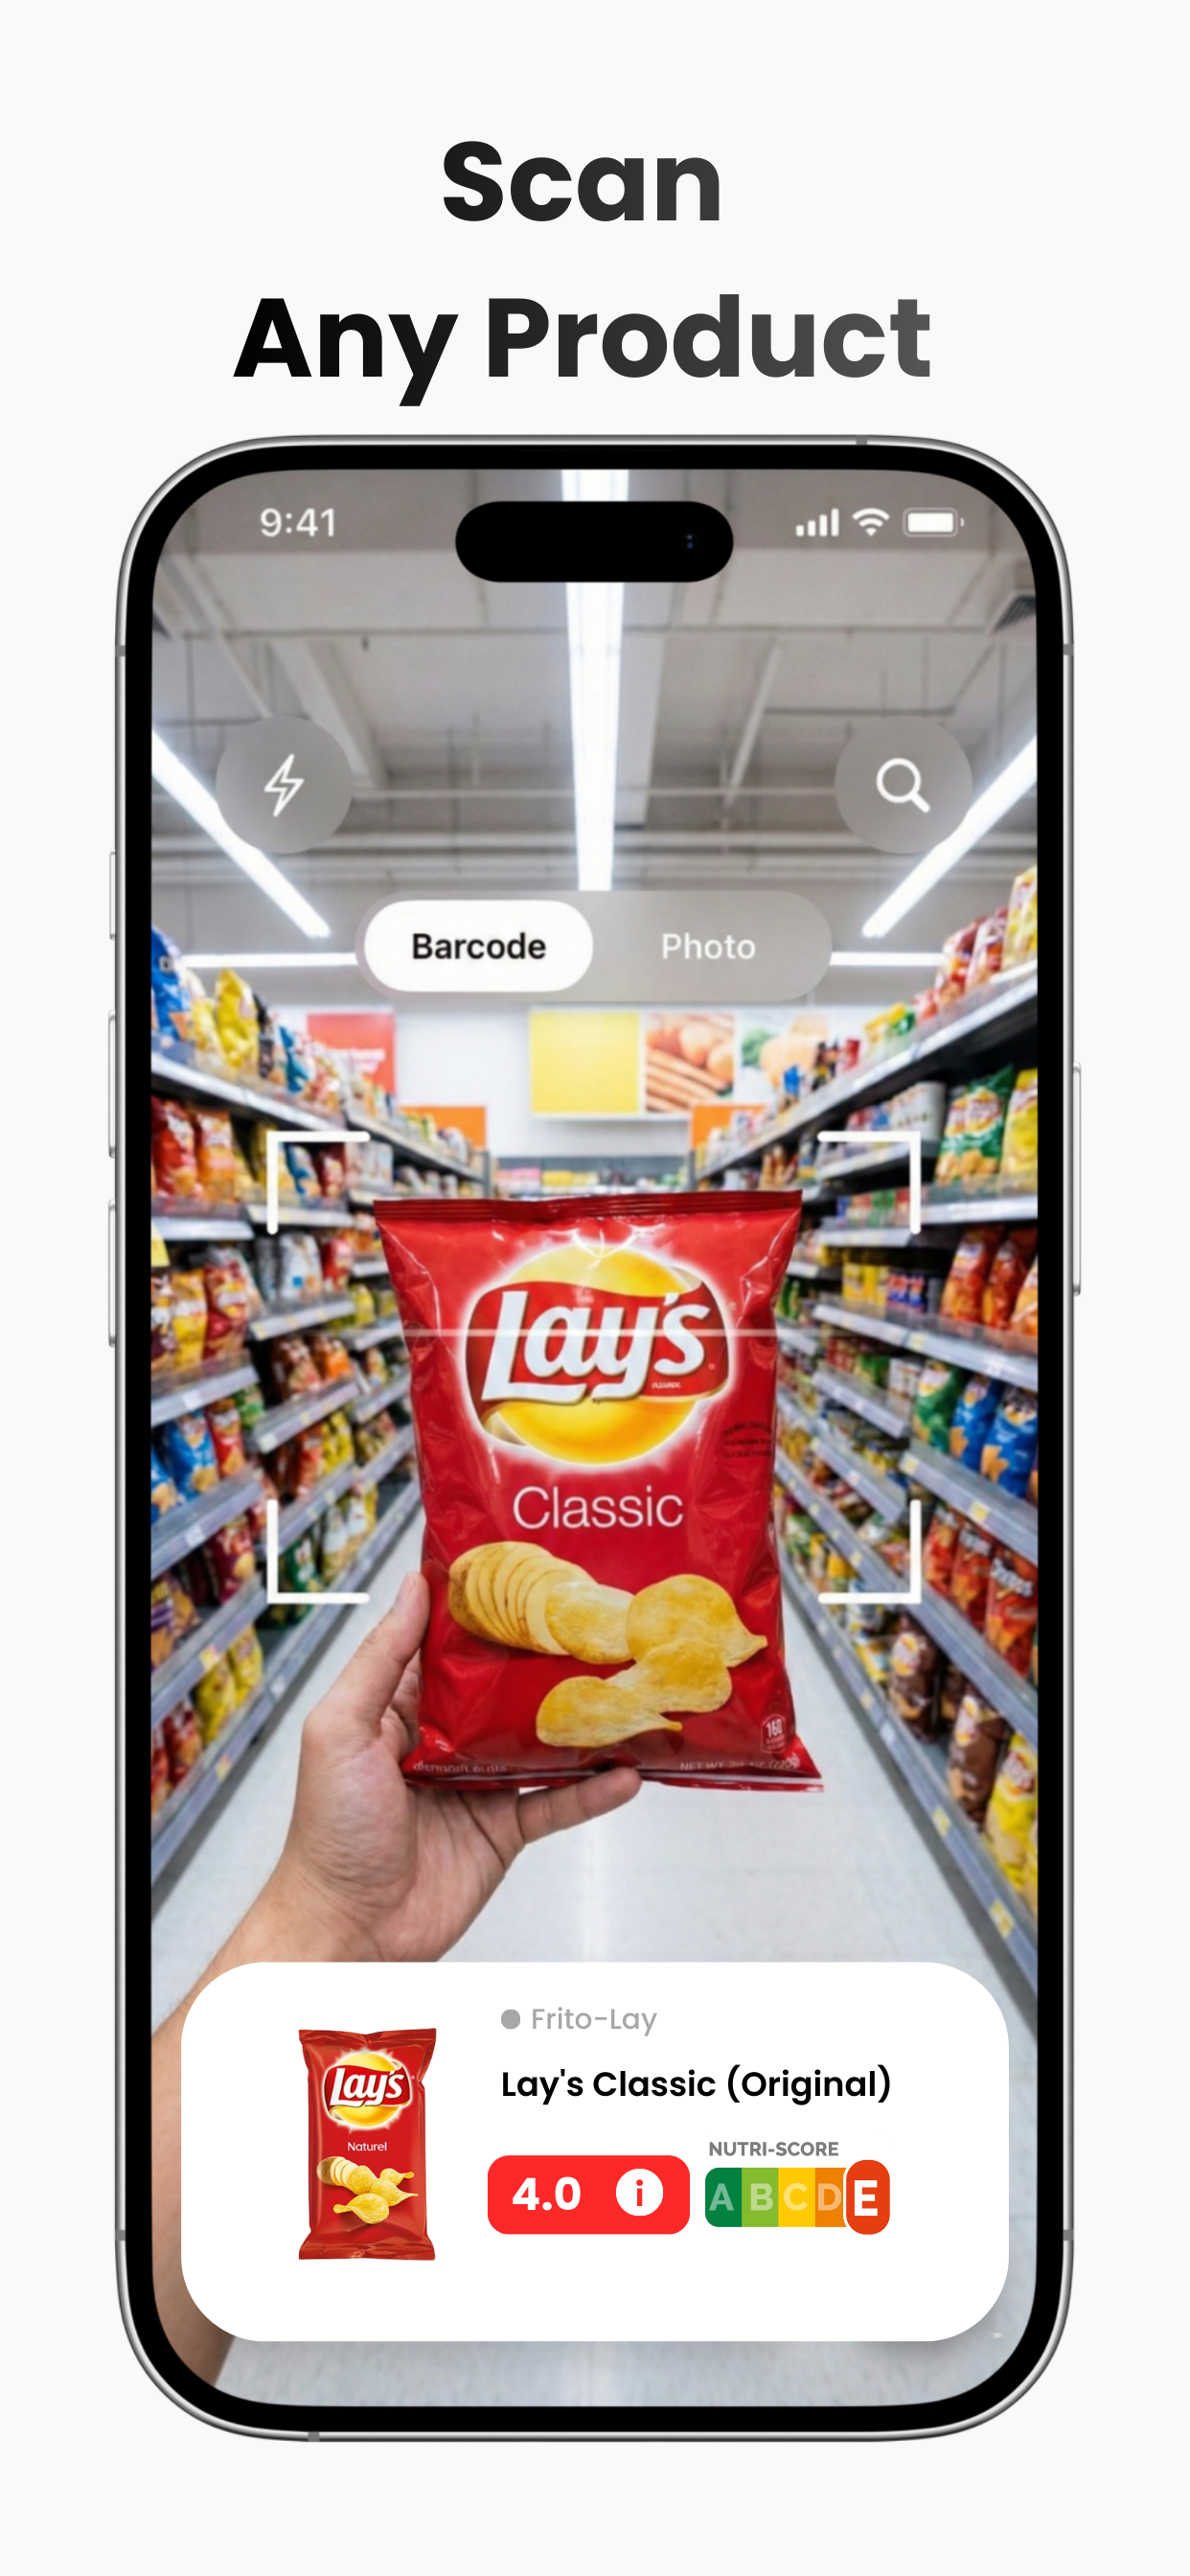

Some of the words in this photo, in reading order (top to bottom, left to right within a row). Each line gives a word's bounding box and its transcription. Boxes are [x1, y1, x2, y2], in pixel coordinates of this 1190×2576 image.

[261, 508, 334, 537] 9:41
[413, 932, 546, 960] Barcode
[661, 932, 756, 960] Photo
[481, 1290, 711, 1405] Lay's
[513, 1484, 683, 1530] Classic
[767, 1718, 782, 1737] 160
[532, 2006, 658, 2037] Frito-Lay
[330, 2068, 404, 2107] Lay's
[502, 2068, 584, 2105] Lay's
[592, 2068, 717, 2097] Classic
[727, 2064, 891, 2106] (Original)
[347, 2141, 387, 2151] Naturel
[709, 2141, 839, 2157] NUTRI-SCORE
[512, 2175, 582, 2211] 4.0
